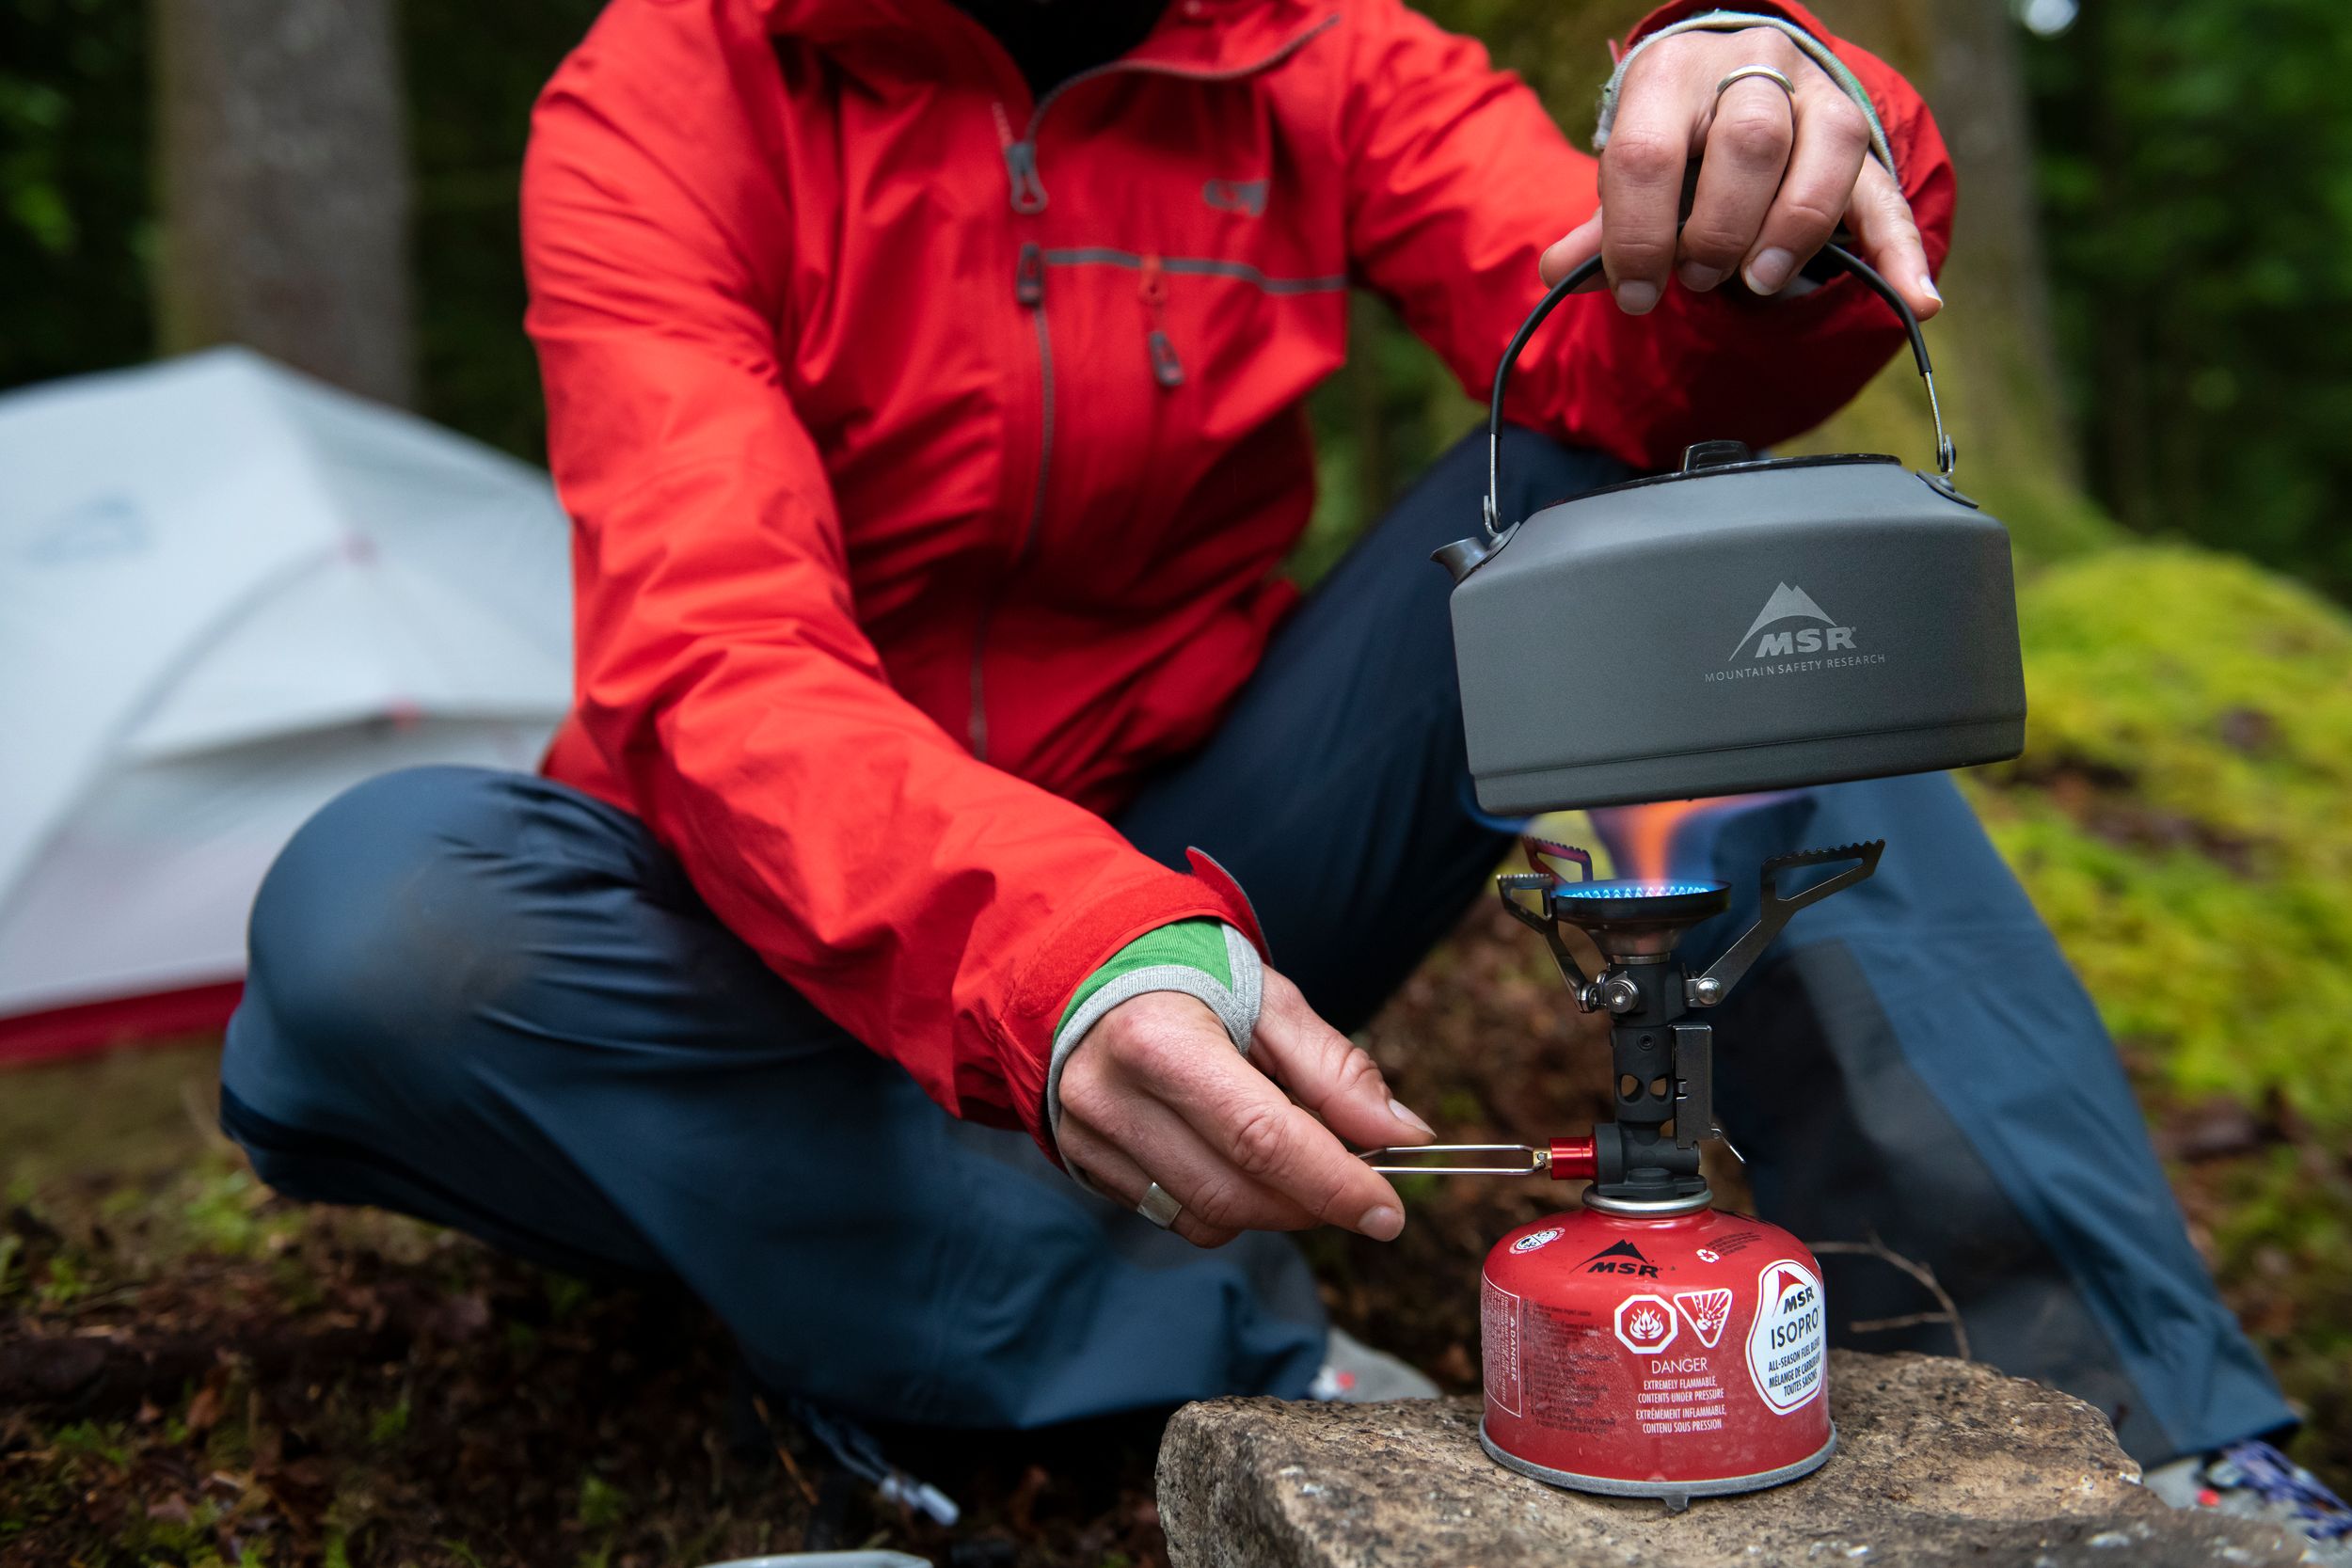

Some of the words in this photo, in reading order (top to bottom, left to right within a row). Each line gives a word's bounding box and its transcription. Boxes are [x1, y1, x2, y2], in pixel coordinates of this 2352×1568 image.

[1755, 626, 1857, 658] MSR
[1704, 665, 1774, 683] MOUNTAIN
[1777, 660, 1822, 674] SAFETY
[1827, 654, 1885, 669] RESEARCH
[1587, 1261, 1659, 1279] MSR
[1783, 1286, 1815, 1315] MSR
[1771, 1307, 1819, 1351] ISOPRO
[1651, 1356, 1708, 1374] DANGER
[1769, 1350, 1801, 1372] ALL-SEASON
[1644, 1379, 1678, 1390] EXTREMELY
[1638, 1393, 1670, 1403] CONTENTS
[1671, 1391, 1693, 1402] UNDER
[1694, 1387, 1724, 1402] PRESSURE
[1643, 1422, 1673, 1433] CONTENU
[1674, 1421, 1692, 1433] SOUS
[1692, 1418, 1722, 1431] PRESSION
